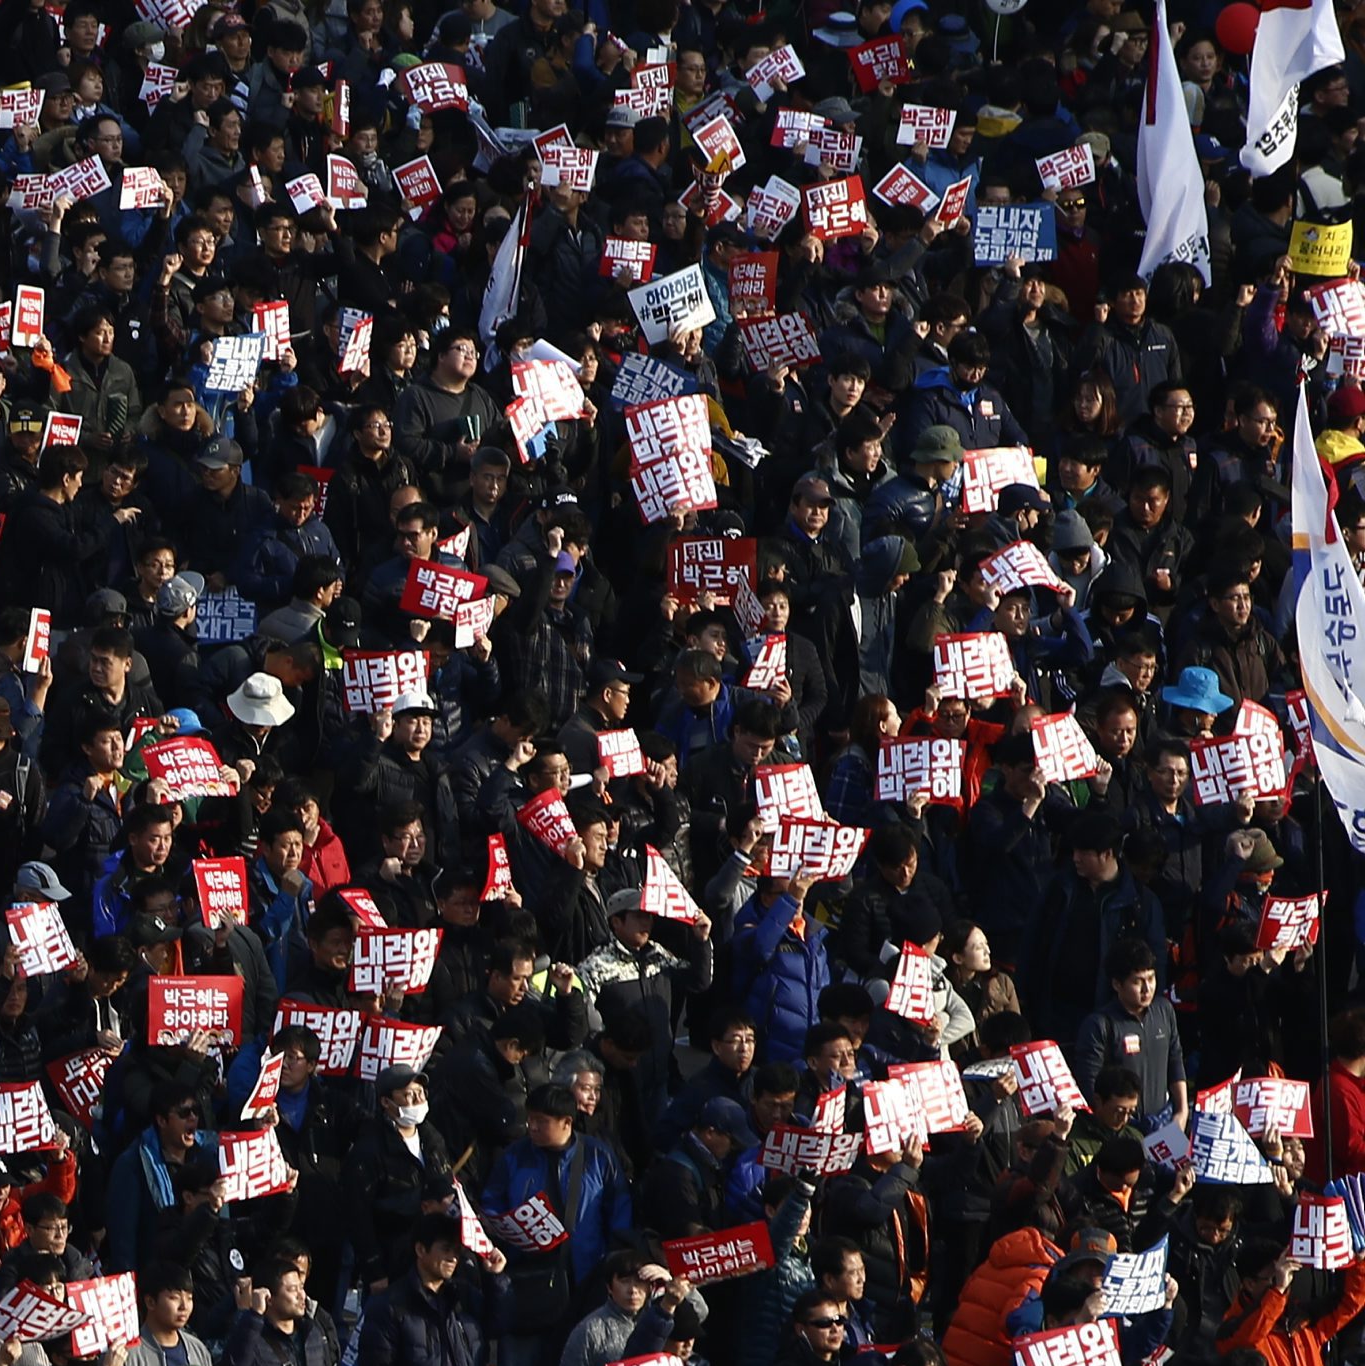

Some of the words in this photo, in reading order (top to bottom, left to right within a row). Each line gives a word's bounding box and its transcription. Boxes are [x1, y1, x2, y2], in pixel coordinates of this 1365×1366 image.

[411, 80, 466, 104] 박근혜
[900, 105, 951, 128] 박근혜
[543, 149, 593, 170] 박근혜
[1039, 148, 1089, 177] 박근혜
[812, 200, 868, 228] 박근혜
[977, 207, 1041, 230] 끝내자
[605, 240, 652, 261] 재벌도
[646, 271, 700, 304] 하야하라
[417, 567, 476, 598] 박근혜
[934, 633, 1010, 674] 내려와
[156, 748, 213, 768] 박근혜는
[878, 741, 960, 772] 내려와
[1190, 738, 1282, 776] 내려와
[772, 821, 863, 858] 내려와
[354, 930, 437, 966] 내려와
[162, 988, 228, 1008] 박근혜는
[162, 1008, 228, 1027] 하야하라
[1235, 1082, 1303, 1107] 박근혜
